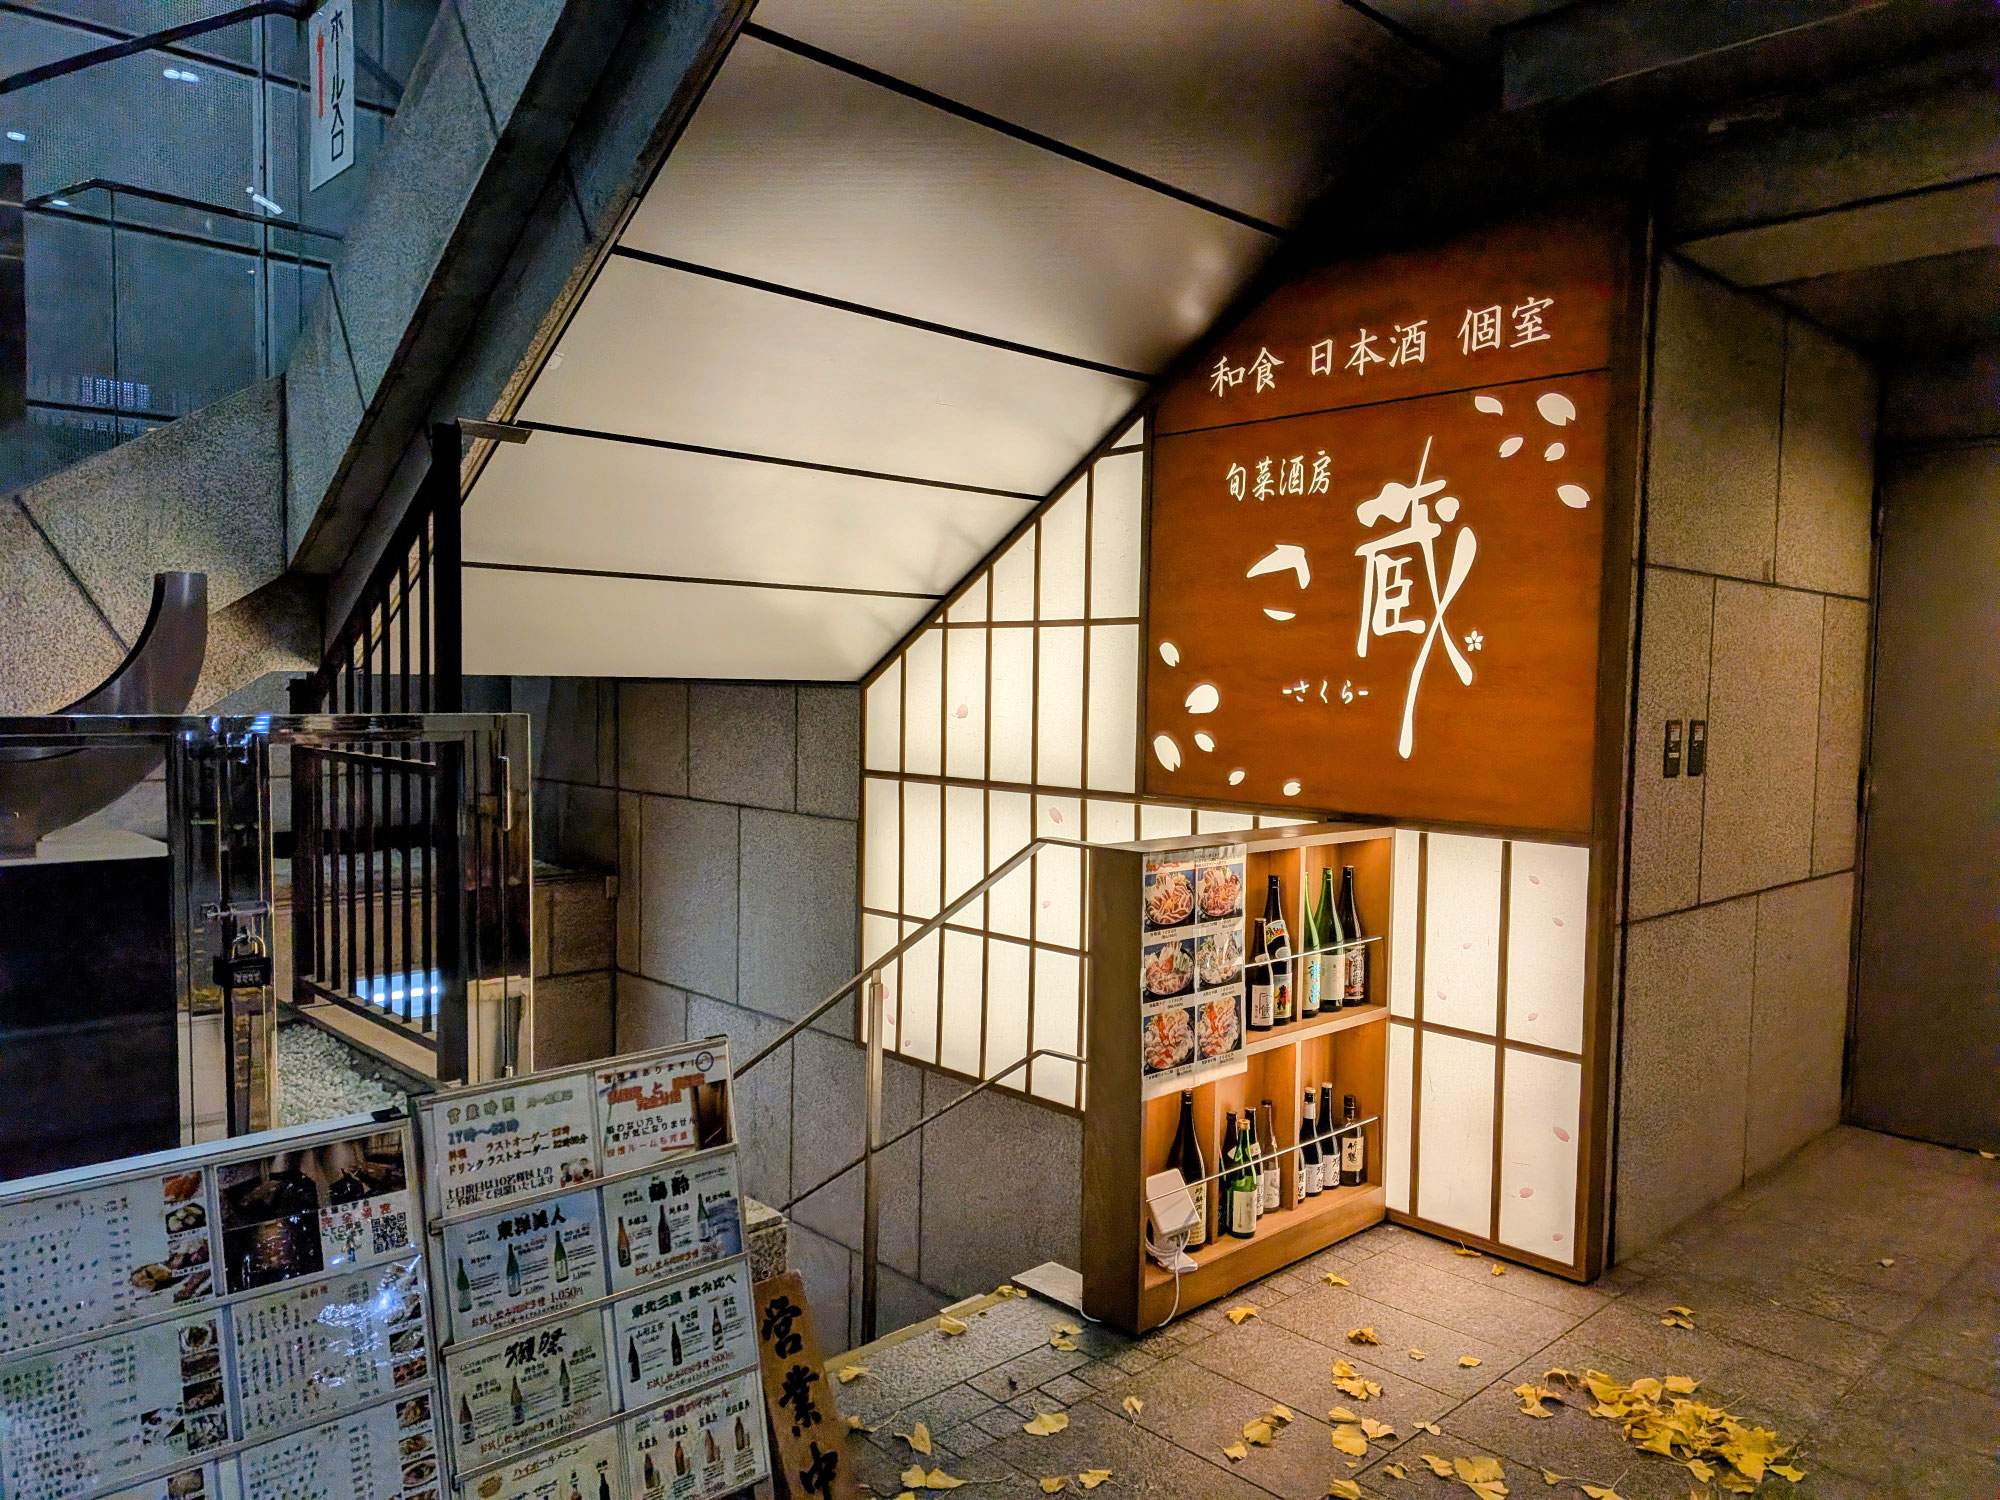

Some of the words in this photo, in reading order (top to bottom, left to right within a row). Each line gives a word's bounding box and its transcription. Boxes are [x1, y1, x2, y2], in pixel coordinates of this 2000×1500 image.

[331, 10, 345, 162] ホール入口
[1209, 346, 1284, 398] 和食
[1310, 319, 1427, 376] 日本酒
[1457, 296, 1554, 355] 個室
[1225, 451, 1332, 502] 旬菜酒房
[497, 1203, 566, 1241] 東洋美人
[761, 1295, 838, 1500] 営業中
